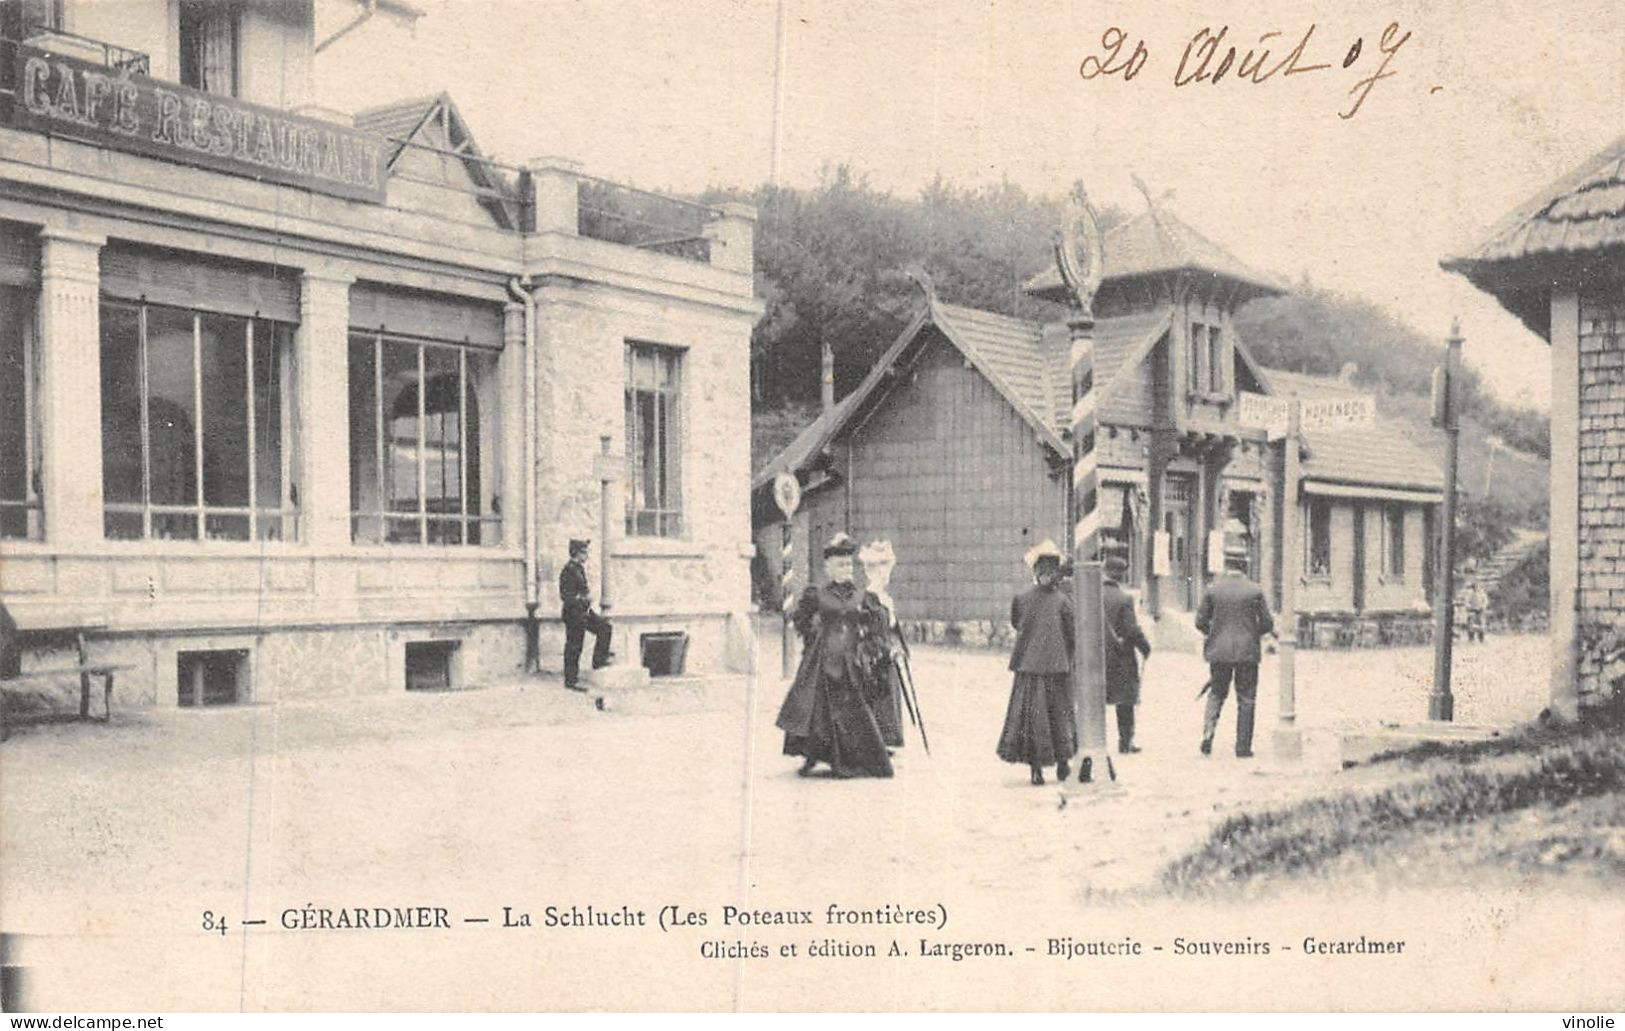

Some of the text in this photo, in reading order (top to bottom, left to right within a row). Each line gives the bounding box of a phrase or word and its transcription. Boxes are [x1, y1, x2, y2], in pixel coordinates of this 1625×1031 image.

[1079, 26, 1149, 82] 20
[23, 56, 381, 189] CAFÉ RESTAURANT
